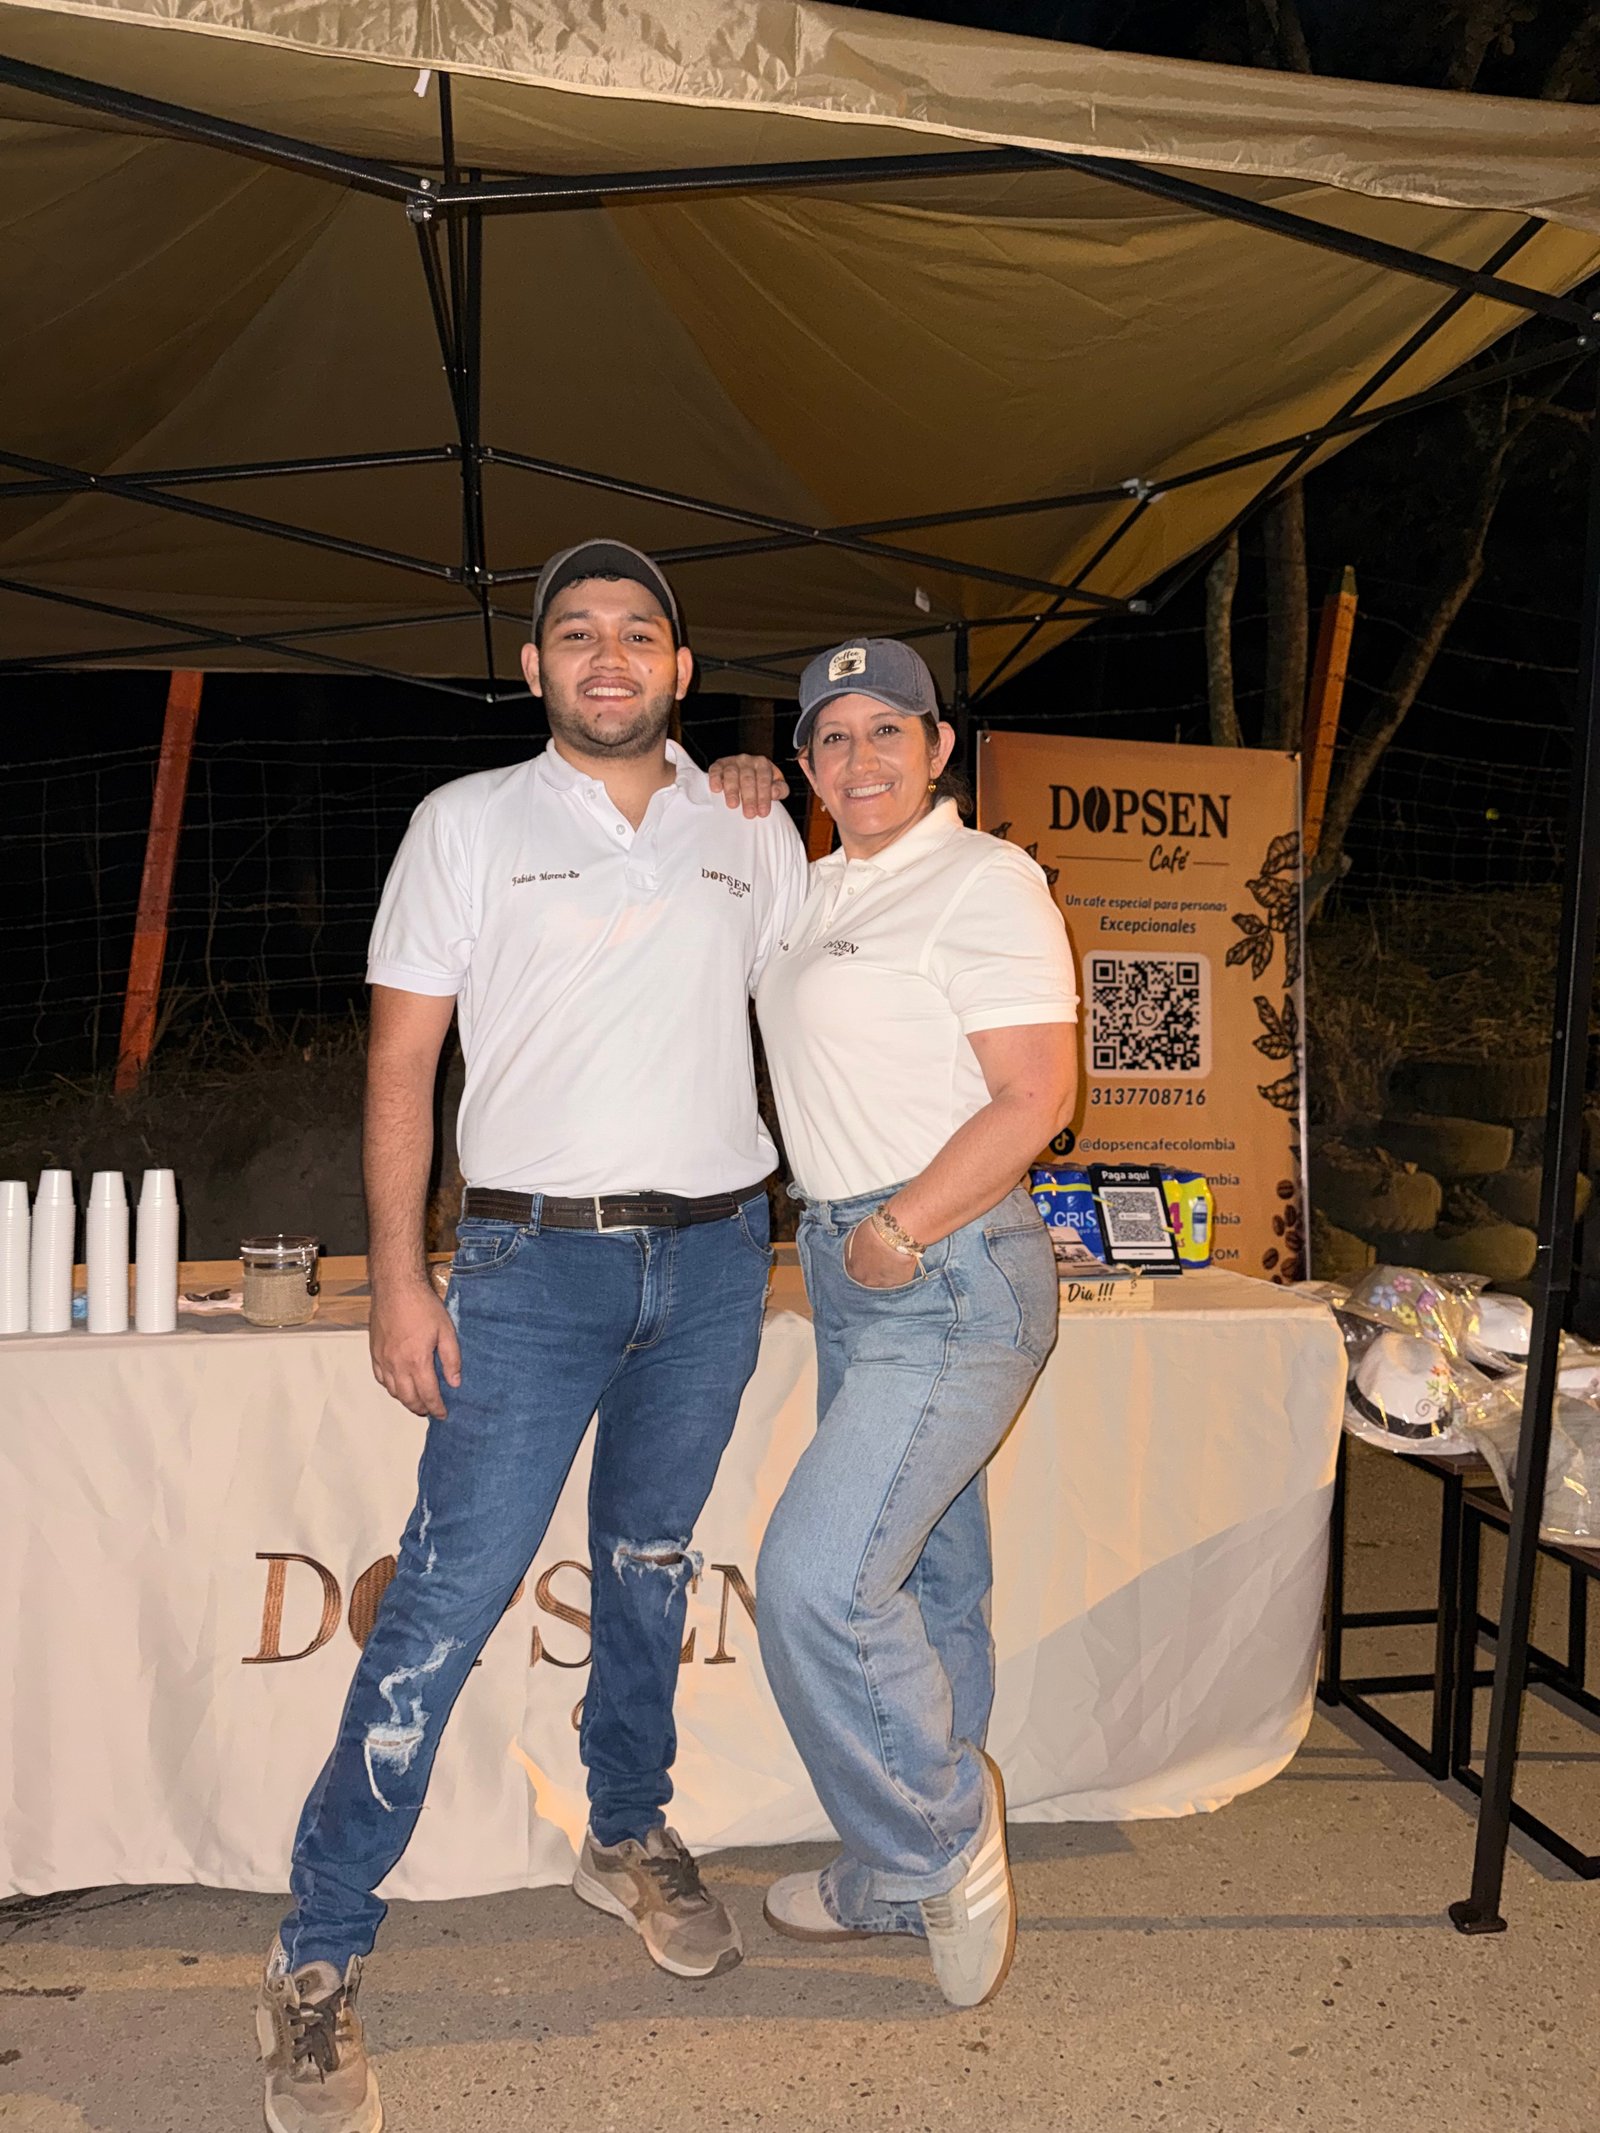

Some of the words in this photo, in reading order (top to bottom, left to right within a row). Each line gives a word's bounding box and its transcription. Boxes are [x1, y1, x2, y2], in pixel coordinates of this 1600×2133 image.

[834, 650, 860, 664] Coffee
[1048, 785, 1231, 838] DOPSEN
[1149, 844, 1190, 873] Café
[539, 871, 567, 881] Moreno
[701, 868, 751, 893] DOPSEN
[1065, 894, 1081, 906] Un
[1108, 896, 1151, 910] especial
[1153, 901, 1178, 911] para
[1180, 901, 1227, 912] personas
[1100, 915, 1196, 934] Excepcionales
[1091, 1087, 1206, 1106] 3137708716
[1079, 1137, 1235, 1153] @dopsencafecolombia
[1101, 1170, 1126, 1182] Paga
